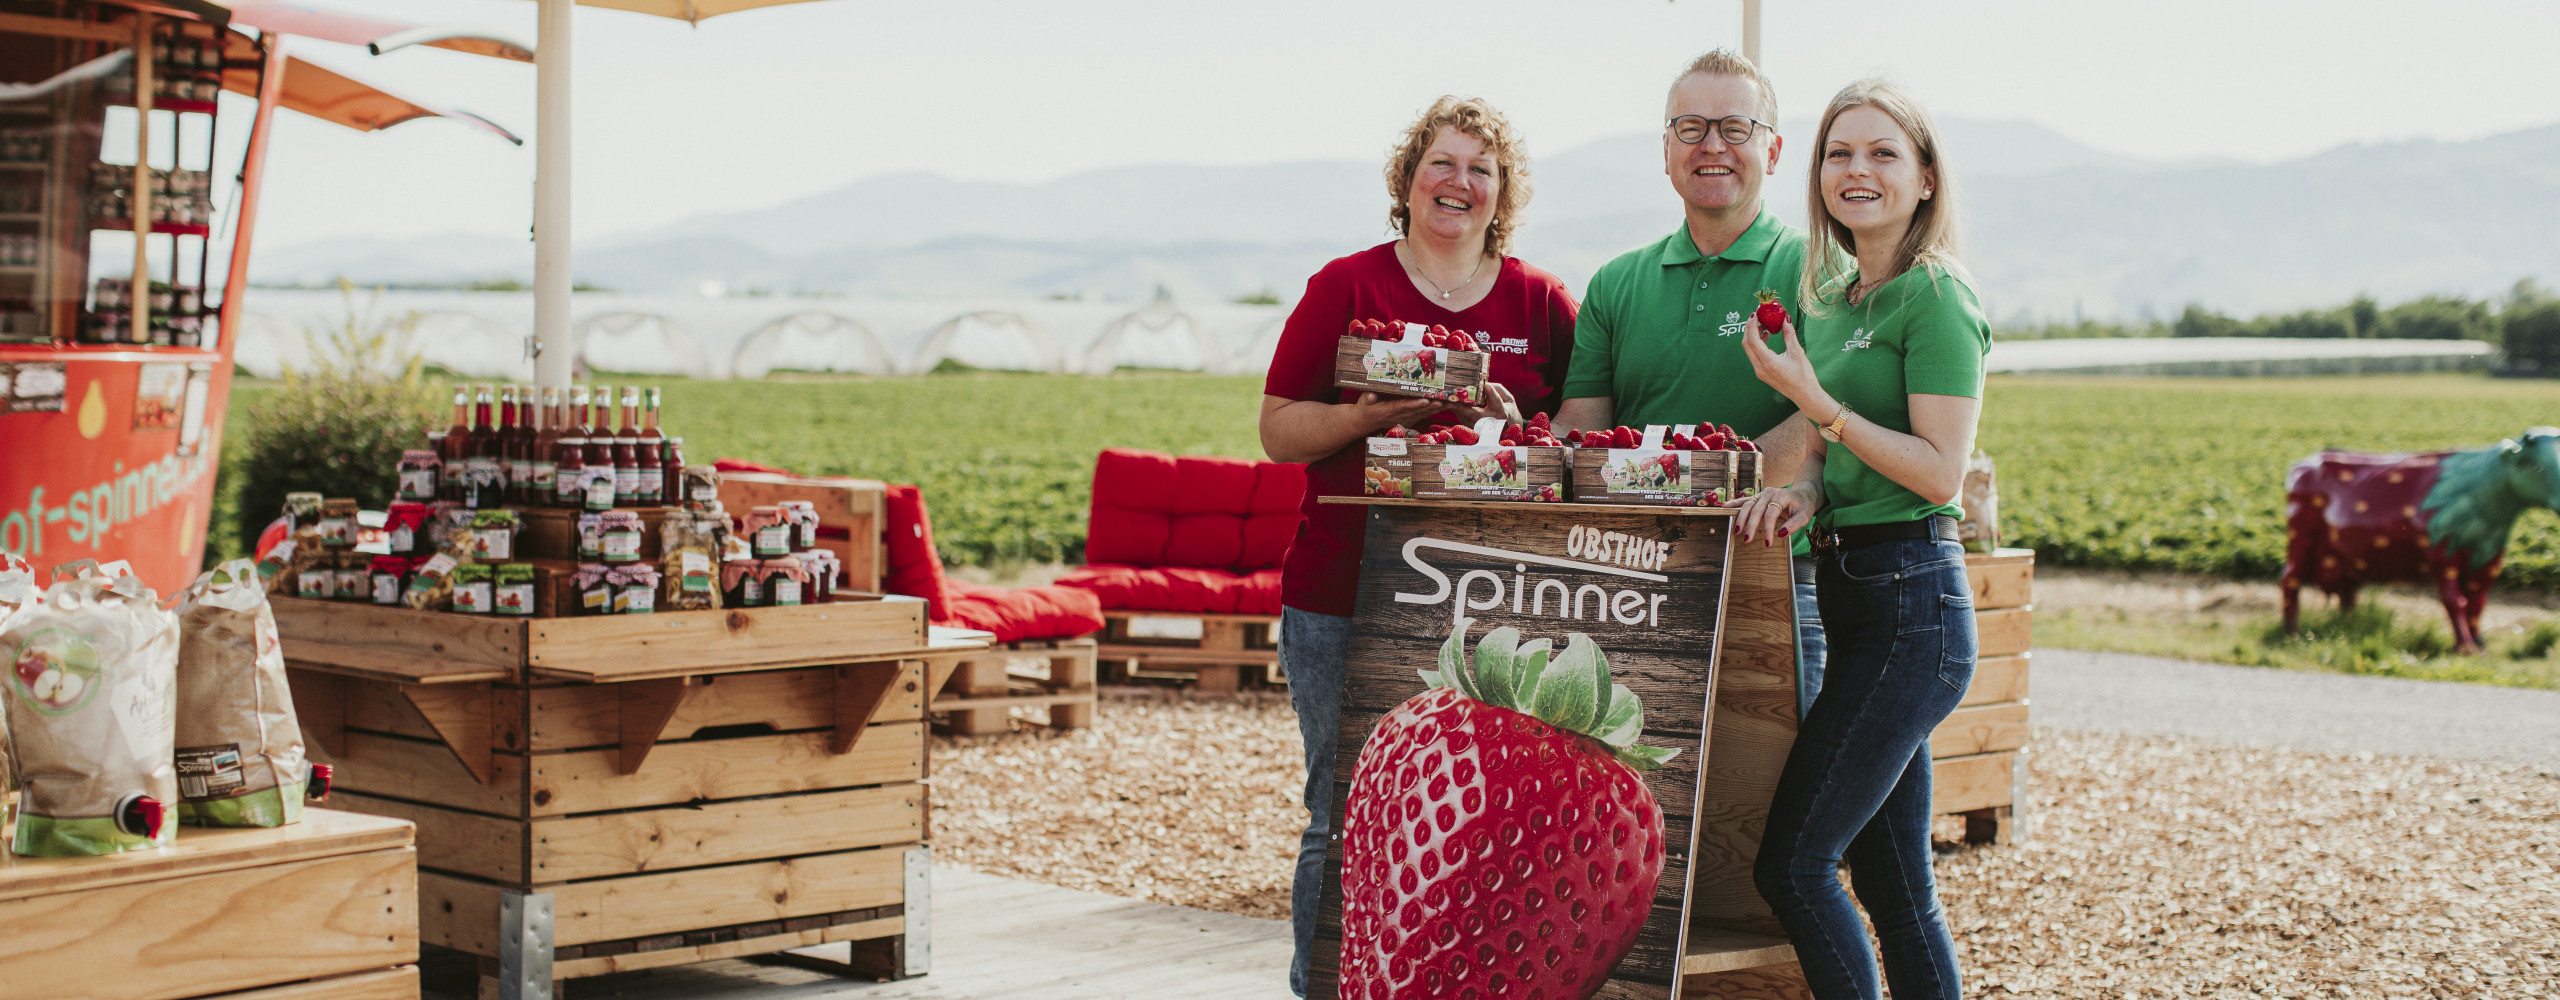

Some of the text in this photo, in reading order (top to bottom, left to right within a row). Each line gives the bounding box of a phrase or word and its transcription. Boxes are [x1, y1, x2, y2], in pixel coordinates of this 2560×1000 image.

[1481, 342, 1528, 355] inner
[1388, 459, 1411, 467] TÄGLIC
[1567, 524, 1669, 571] OBSTHOF
[1394, 536, 1669, 627] Spinner
[178, 761, 212, 775] Spinner
